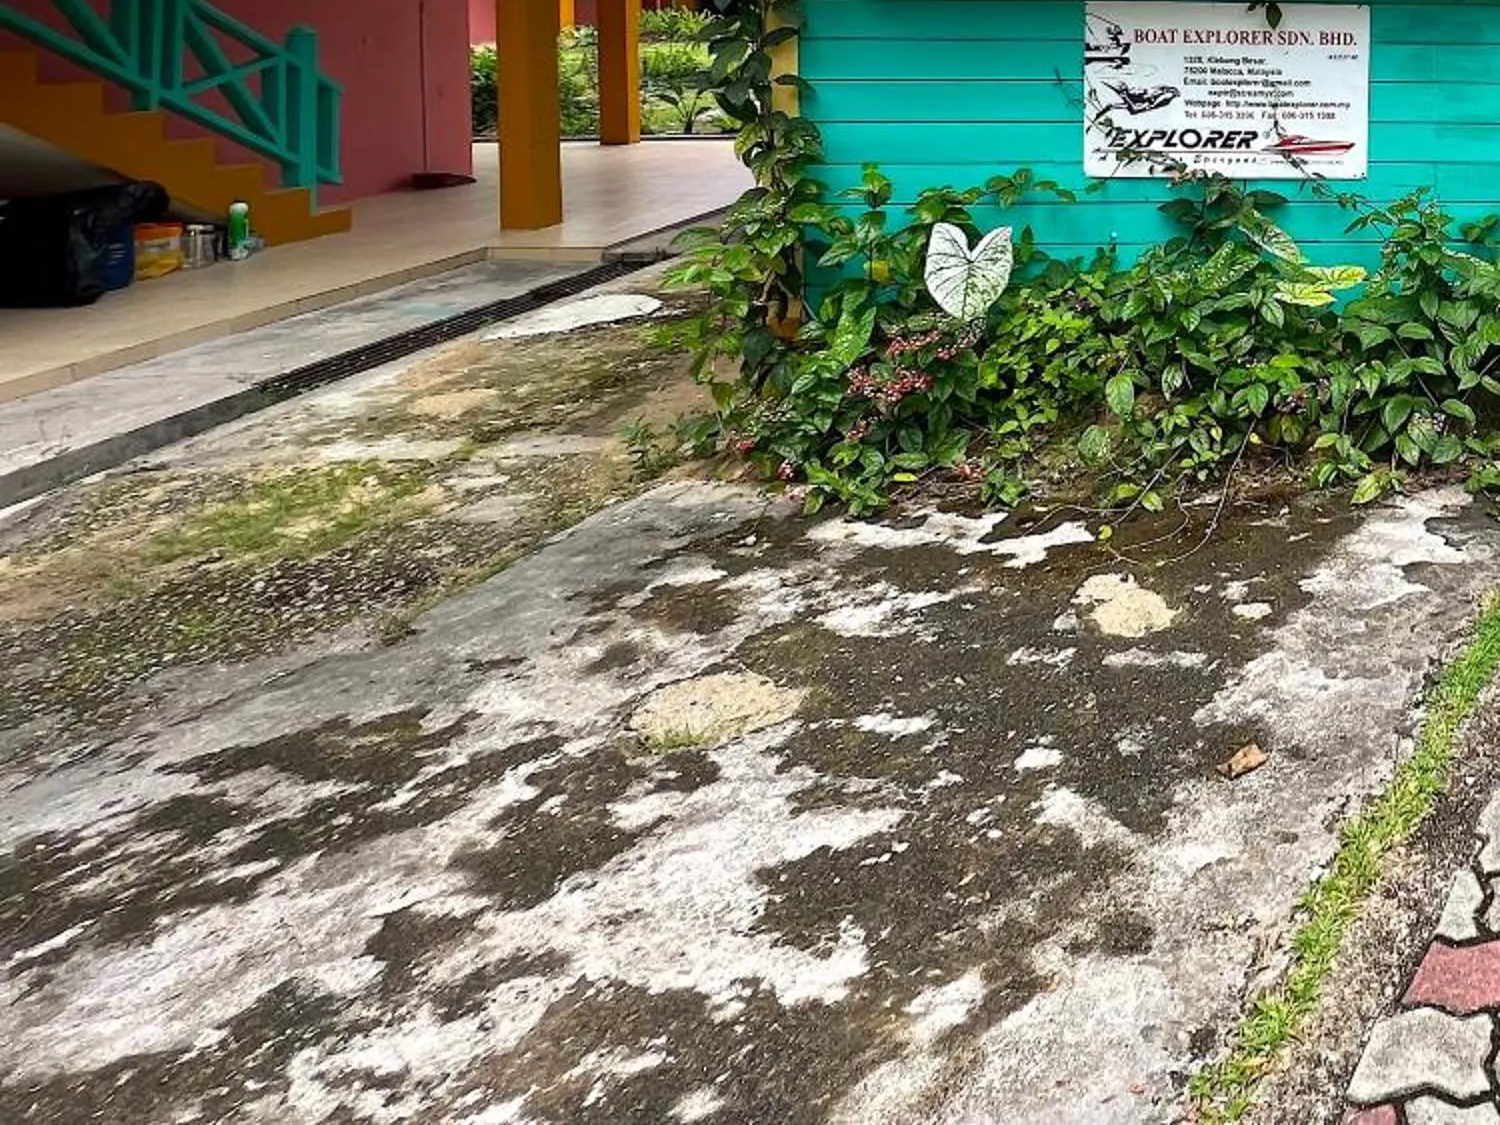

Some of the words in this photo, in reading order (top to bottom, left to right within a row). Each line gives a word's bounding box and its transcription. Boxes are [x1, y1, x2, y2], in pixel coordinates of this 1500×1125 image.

[1134, 29, 1178, 44] BOAT
[1183, 29, 1276, 46] EXPLORER
[1278, 31, 1314, 46] SDN.
[1319, 32, 1358, 47] BHD.
[1110, 129, 1258, 150] EXPLORER
